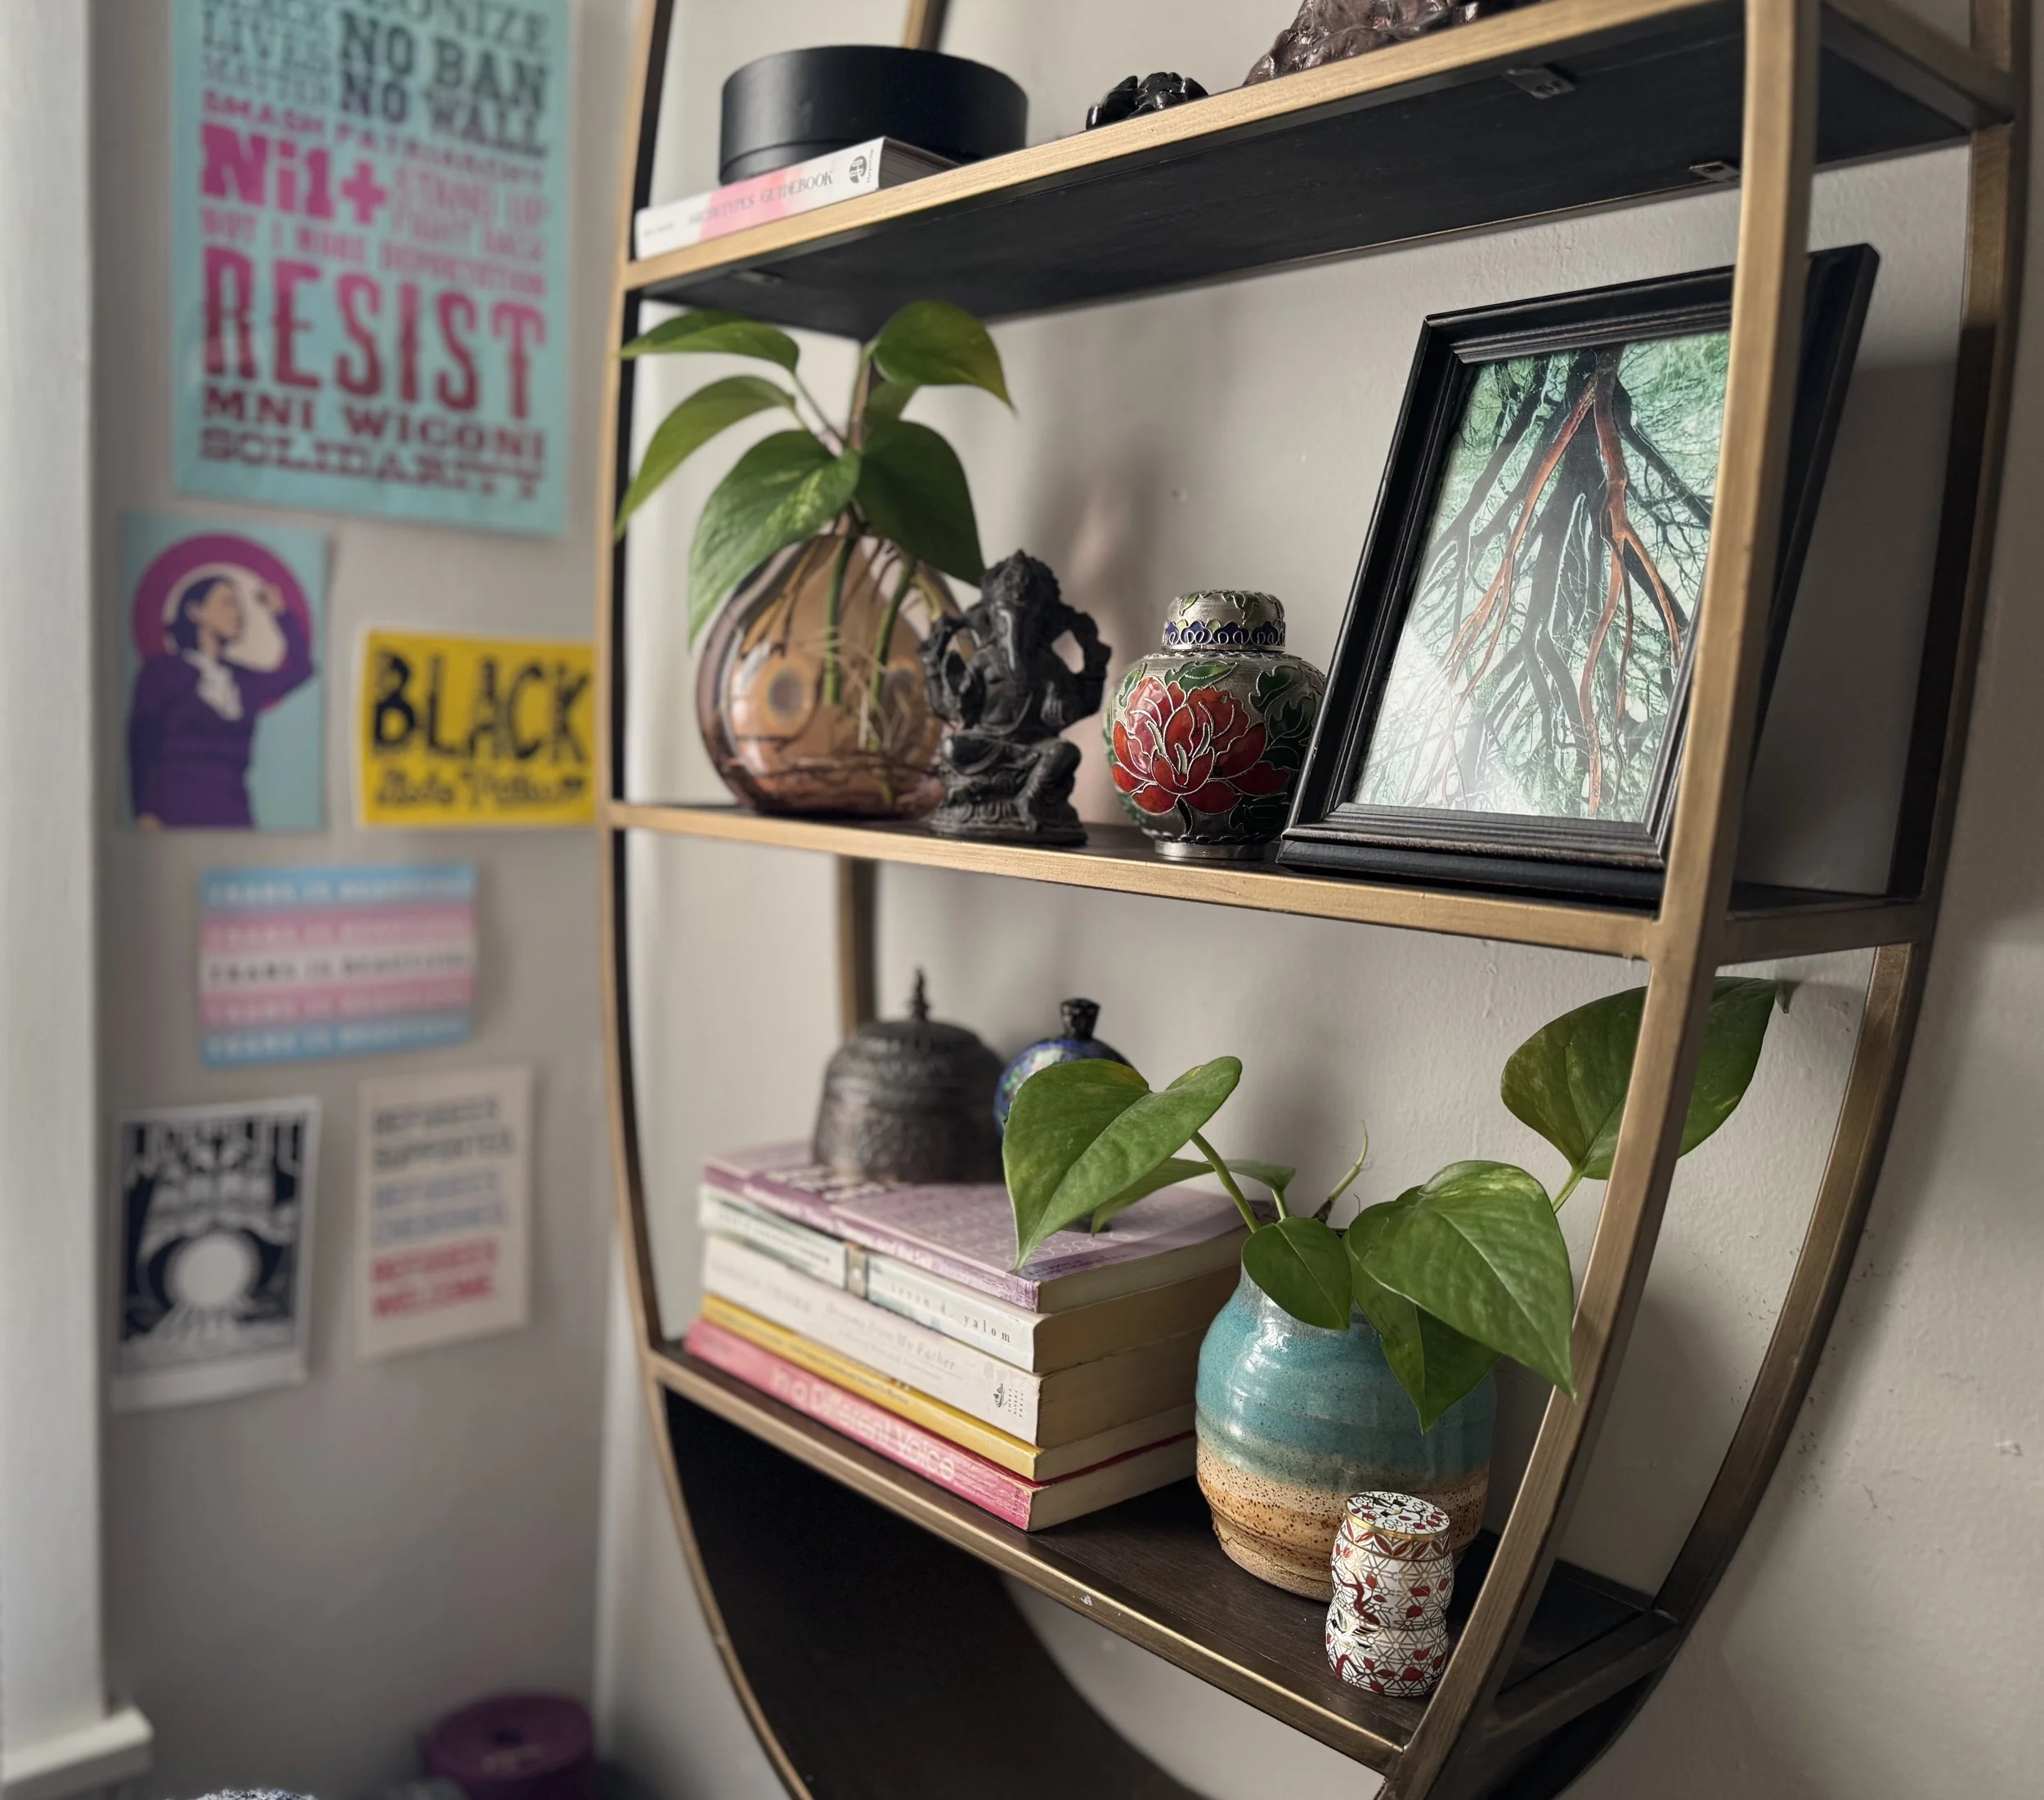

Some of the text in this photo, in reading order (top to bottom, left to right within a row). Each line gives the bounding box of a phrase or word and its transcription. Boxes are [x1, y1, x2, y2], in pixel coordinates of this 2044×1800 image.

[339, 10, 549, 113] NO BAN
[340, 70, 546, 158] NO WALL
[760, 171, 834, 206] GUIDEBOOK
[203, 245, 547, 421] RESIST
[204, 387, 545, 461] MNI WICONI
[199, 428, 543, 499] SOLIDARITY
[374, 649, 589, 765] BLACK
[917, 1342, 955, 1372] Father
[963, 1314, 1011, 1343] yalom
[889, 1418, 955, 1480] Voice
